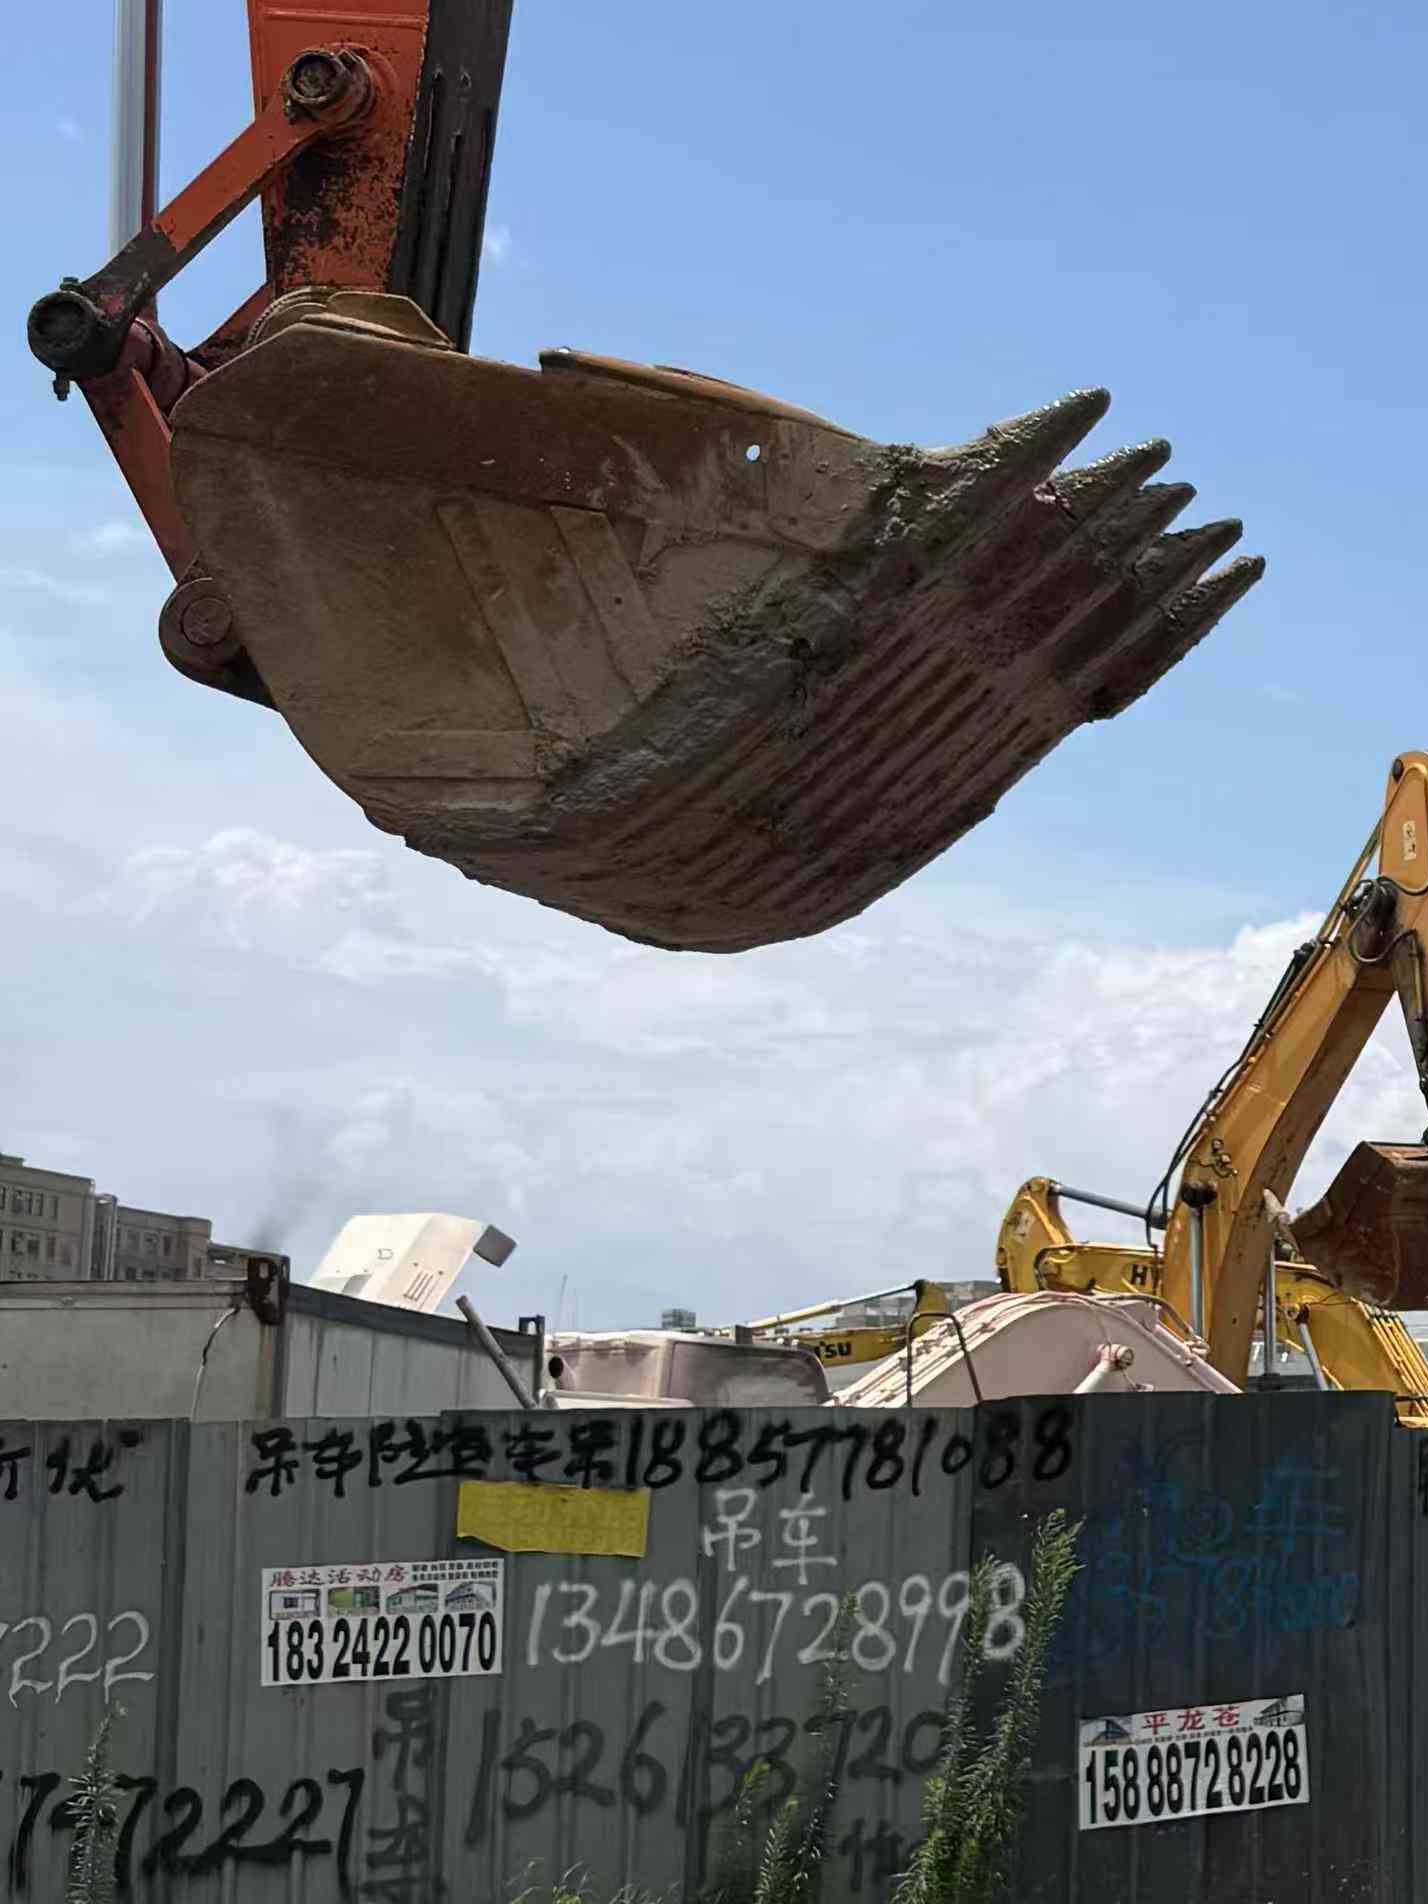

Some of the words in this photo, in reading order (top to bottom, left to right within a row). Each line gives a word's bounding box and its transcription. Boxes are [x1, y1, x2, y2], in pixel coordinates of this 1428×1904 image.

[702, 1488, 838, 1584] 吊车
[0, 1609, 160, 1709] 222
[268, 1619, 323, 1682] 183
[332, 1615, 411, 1679] 2422
[419, 1611, 497, 1674] 0070
[526, 1563, 1026, 1686] 13486728998
[1141, 1706, 1240, 1735] 平龙苍
[1086, 1746, 1140, 1824] 158
[1147, 1738, 1223, 1816] 8872
[1227, 1728, 1301, 1806] 8228
